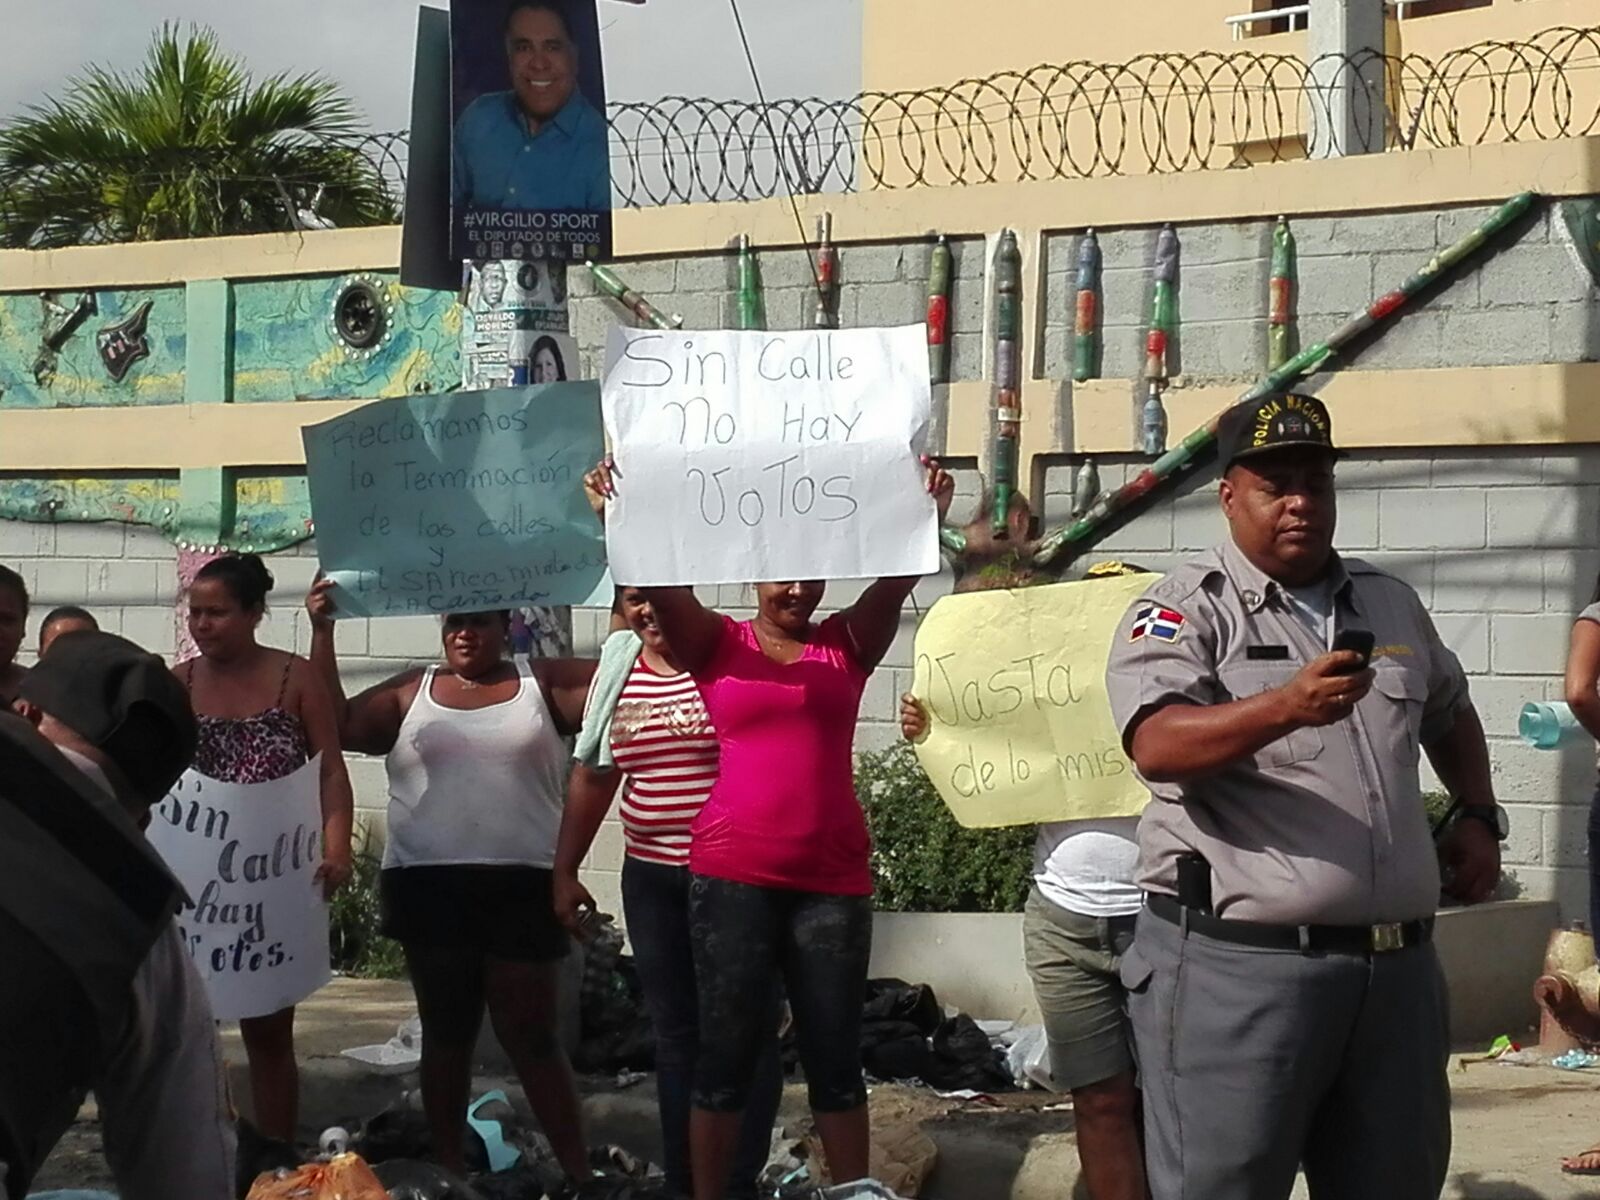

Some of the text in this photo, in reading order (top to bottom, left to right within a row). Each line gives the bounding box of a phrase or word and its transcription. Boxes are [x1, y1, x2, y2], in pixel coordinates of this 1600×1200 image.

[463, 212, 599, 229] #VIRGILIO SPORT
[468, 231, 601, 243] EL DIPUTADO DE TODOS
[622, 333, 854, 387] Sin Calle
[1253, 400, 1282, 447] POLICIA
[351, 450, 570, 491] la Terminación
[360, 504, 390, 536] de
[418, 510, 455, 537] las
[951, 744, 995, 797] de
[1008, 741, 1030, 784] lo
[218, 824, 317, 883] Calle
[195, 880, 265, 943] hay
